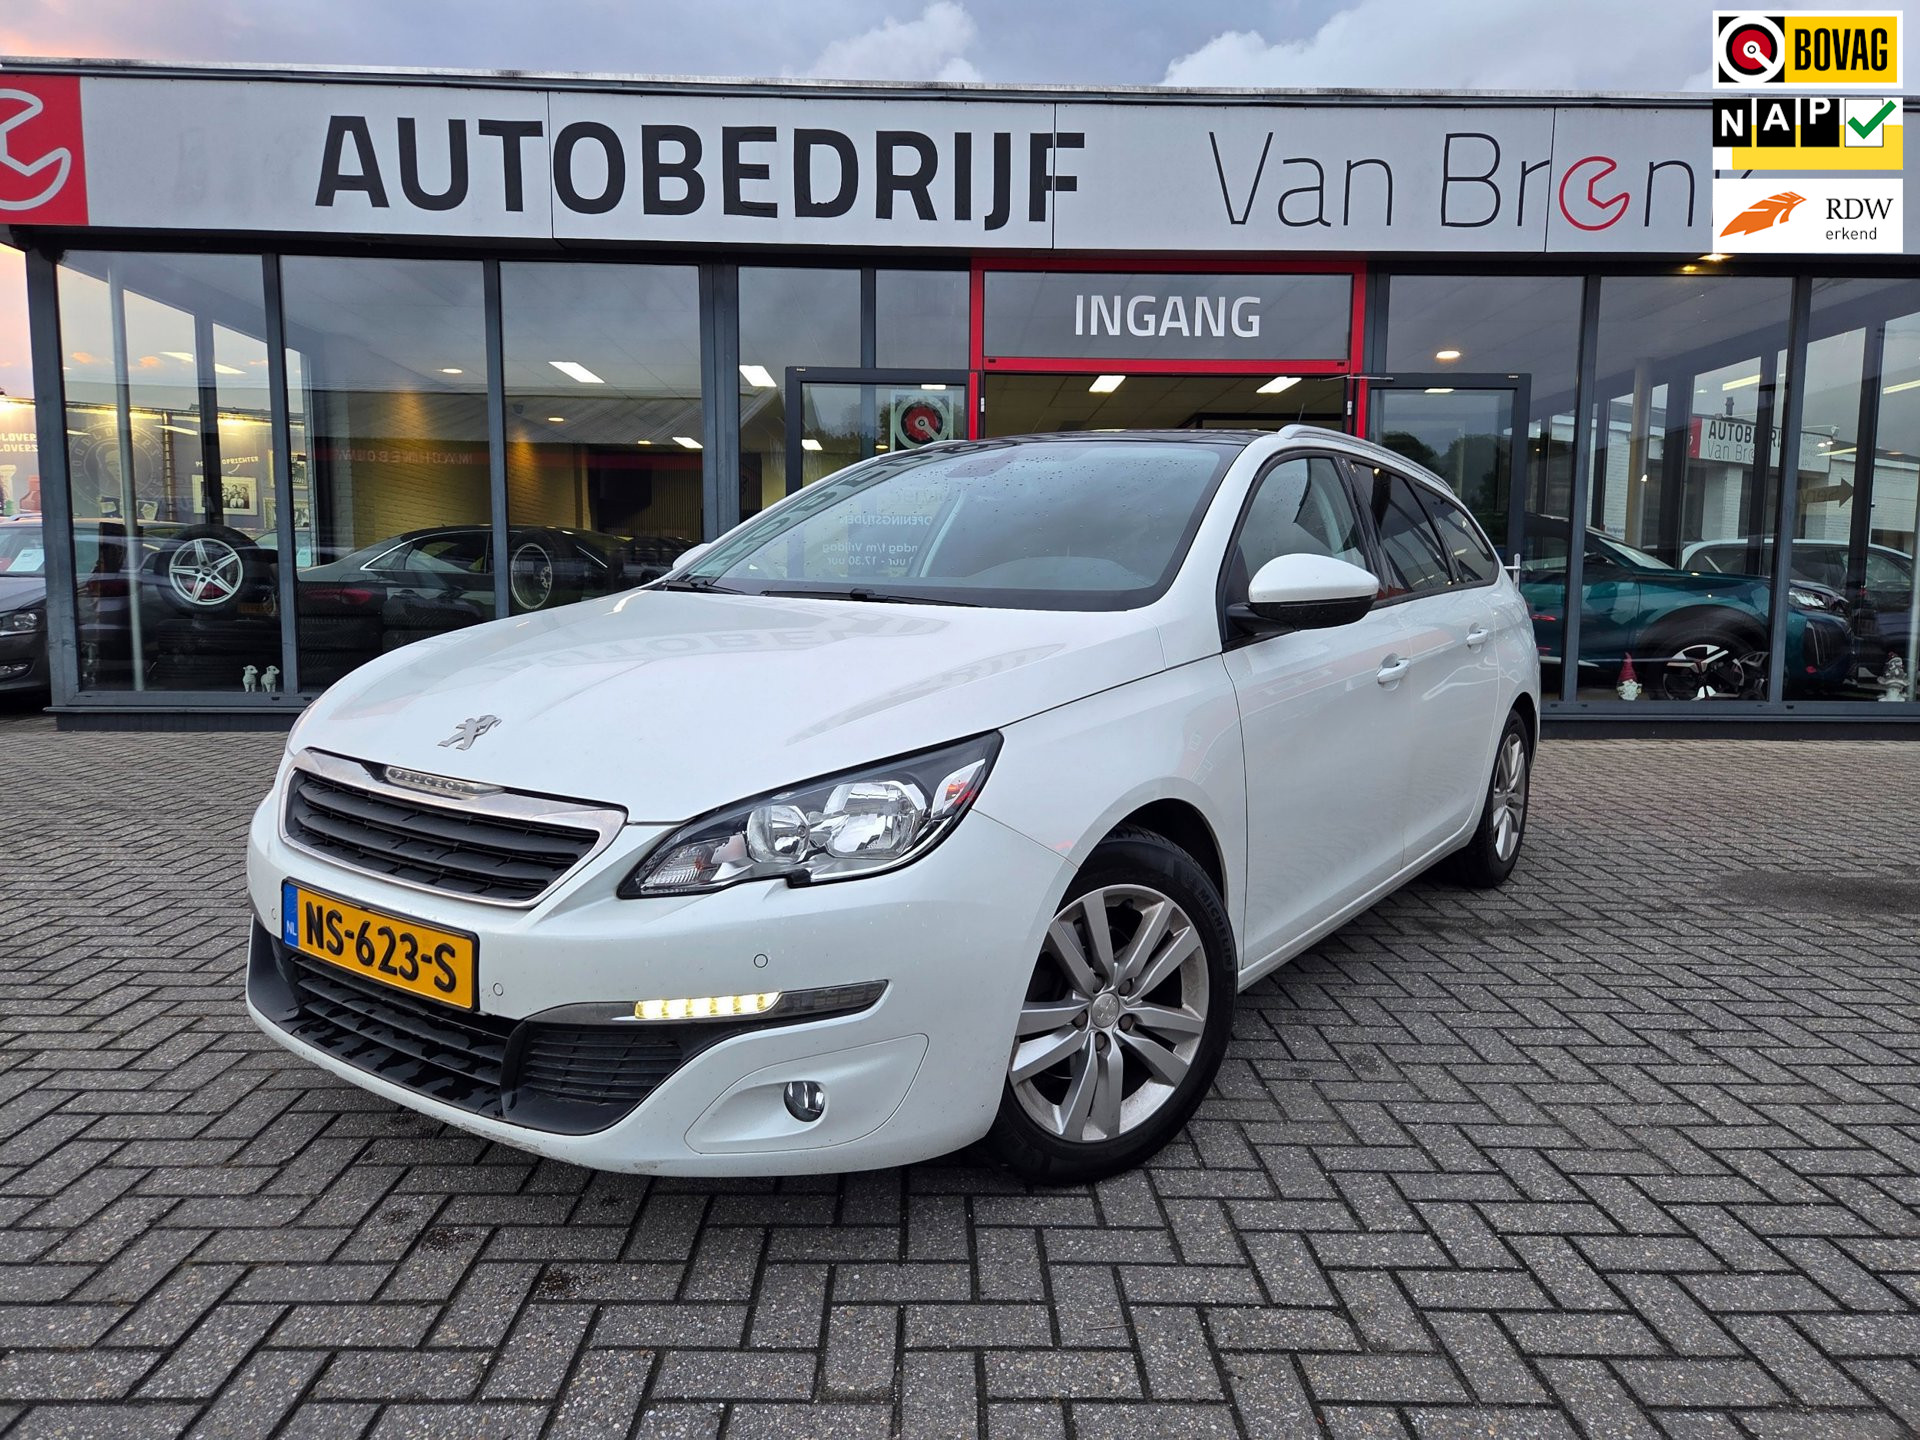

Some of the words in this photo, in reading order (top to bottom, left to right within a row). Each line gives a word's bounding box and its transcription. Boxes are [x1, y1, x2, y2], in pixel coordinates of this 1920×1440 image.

[314, 115, 1086, 231] AUTOBEDRIJF
[1208, 131, 1393, 228] Van
[1440, 132, 1752, 232] Bren
[1075, 295, 1261, 338] INGANG
[0, 432, 37, 442] LOVER
[1707, 440, 1730, 459] Van
[286, 920, 298, 937] NL
[305, 901, 457, 993] NS-623-S
[1198, 887, 1234, 967] MICHELIN
